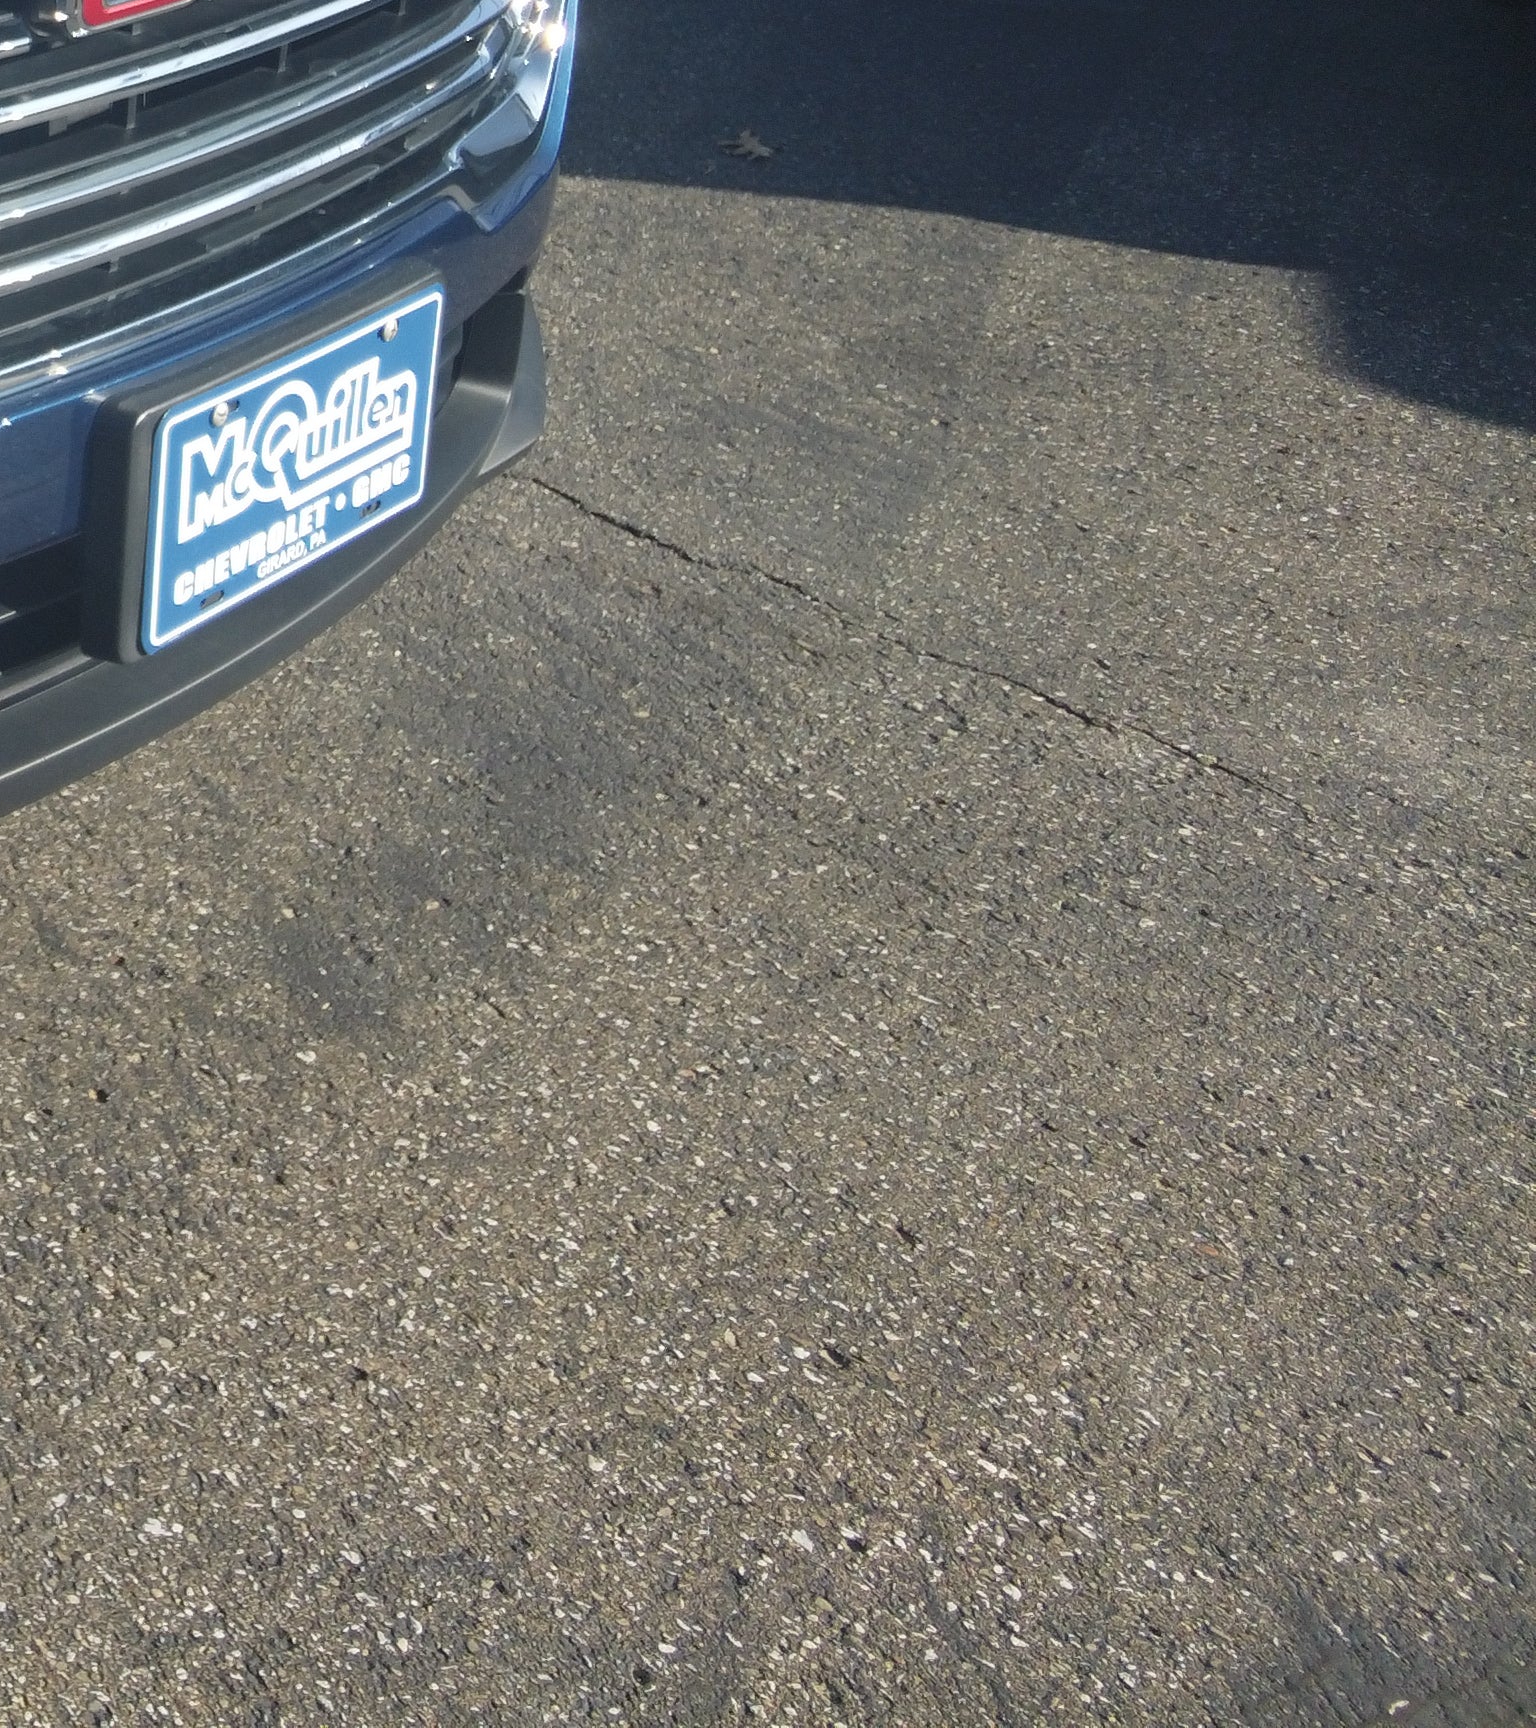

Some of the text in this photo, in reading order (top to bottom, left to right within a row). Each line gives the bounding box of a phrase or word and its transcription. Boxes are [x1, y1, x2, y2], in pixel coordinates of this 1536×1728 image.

[177, 356, 417, 544] McQuillen
[173, 454, 411, 605] CHEVROLET GMC
[308, 528, 327, 553] PA
